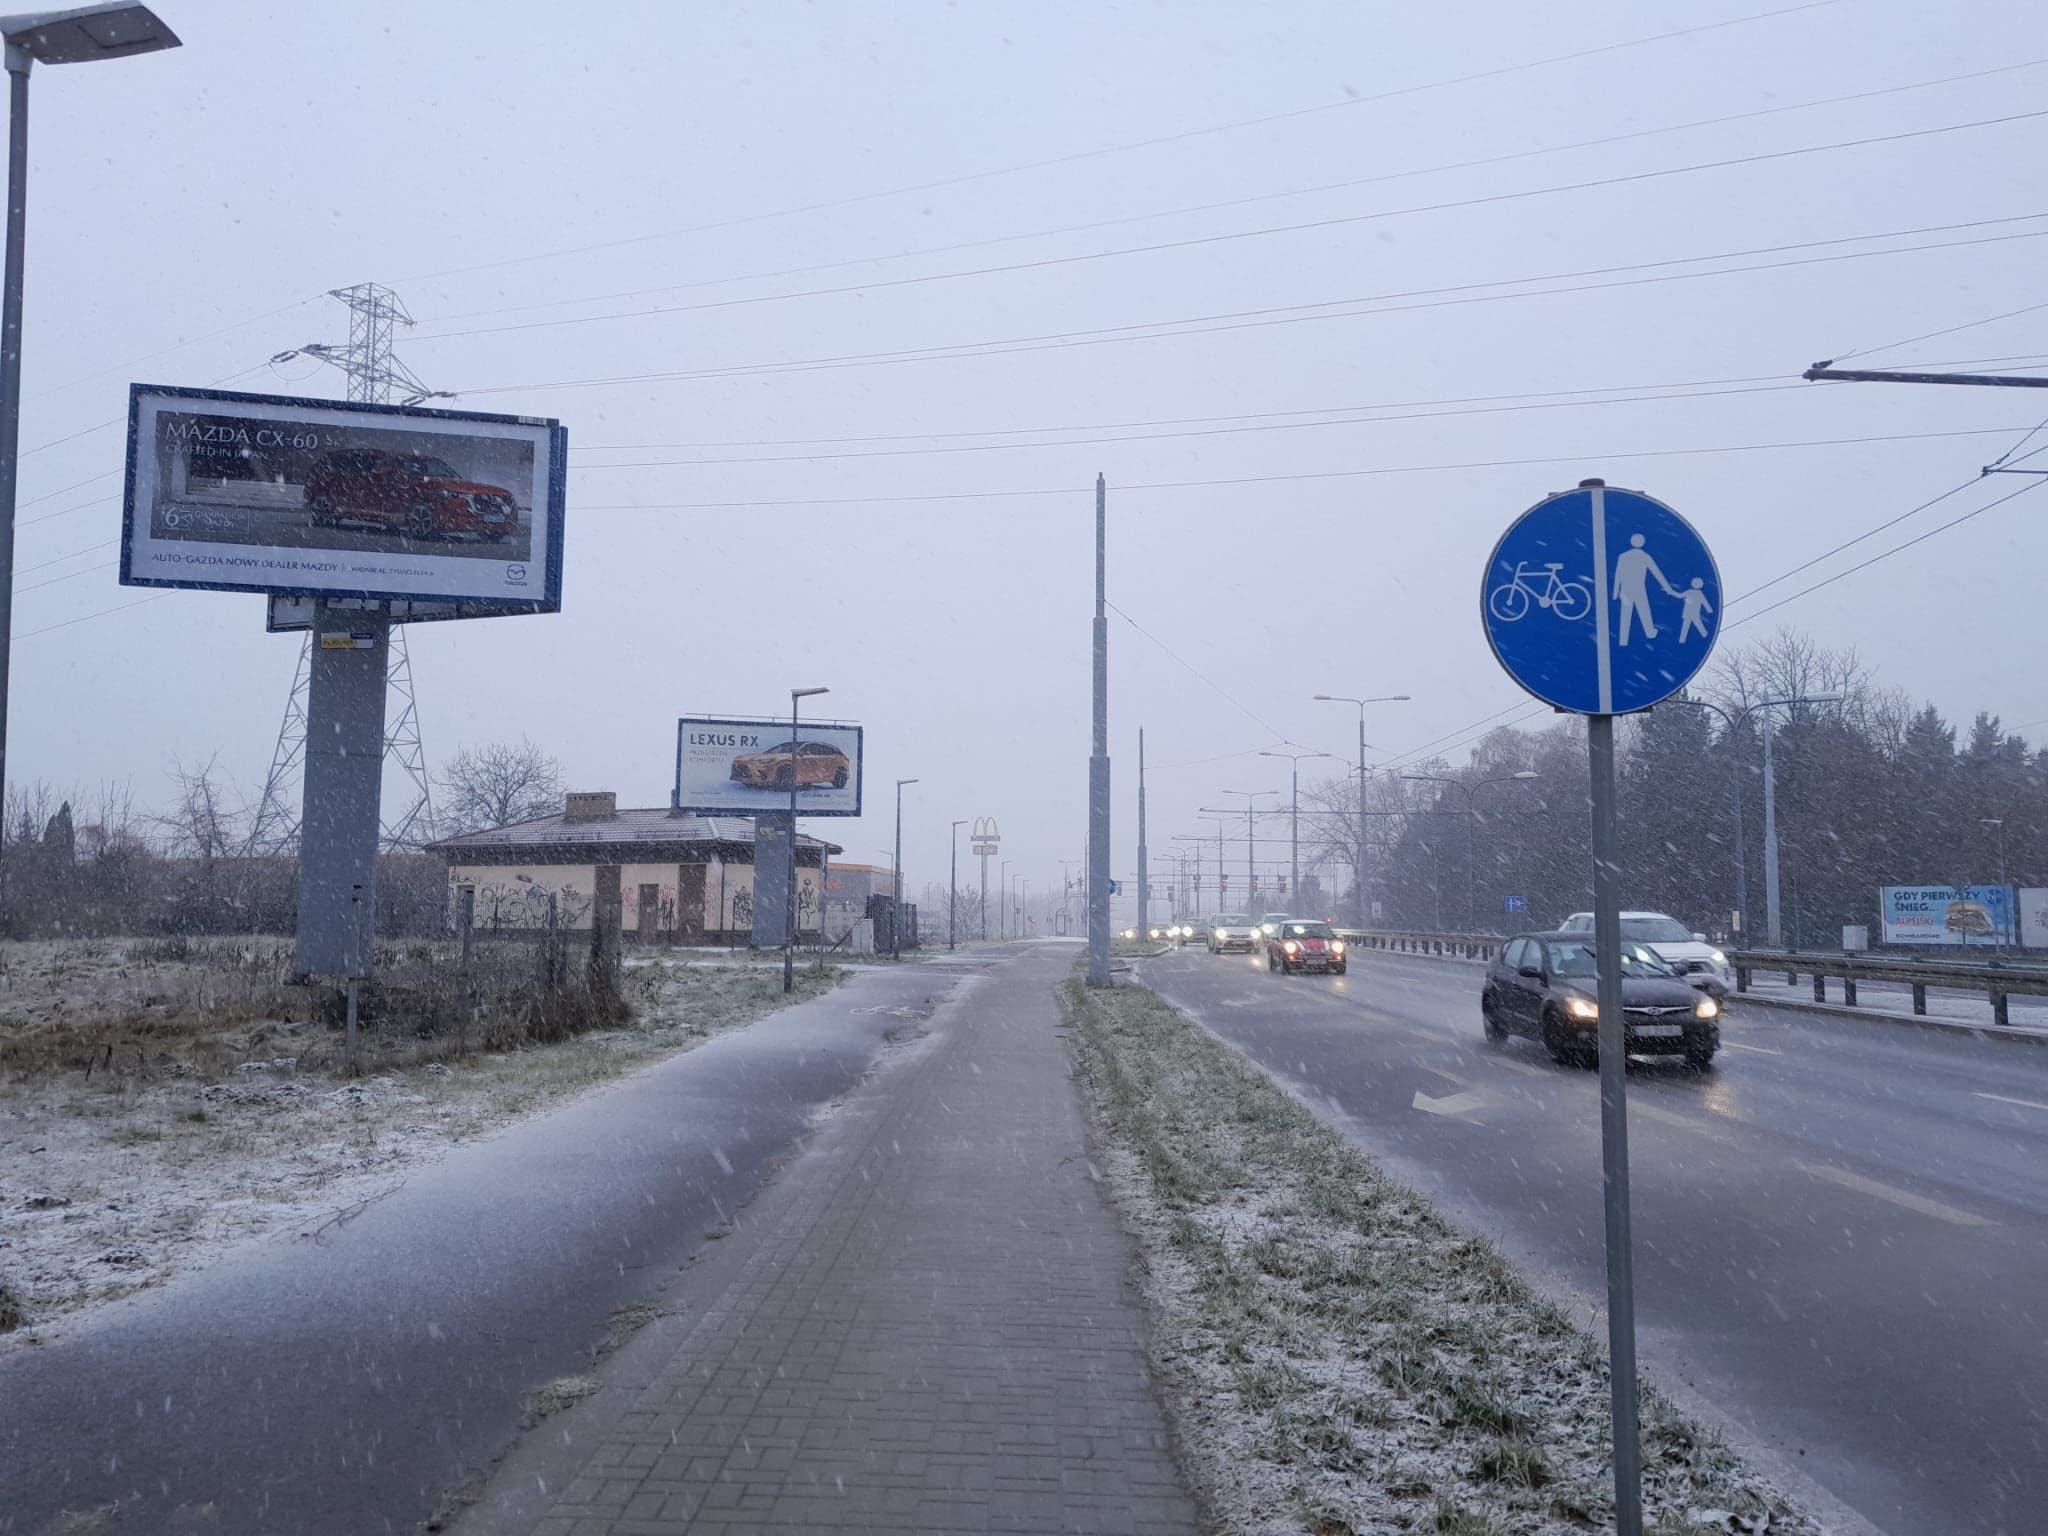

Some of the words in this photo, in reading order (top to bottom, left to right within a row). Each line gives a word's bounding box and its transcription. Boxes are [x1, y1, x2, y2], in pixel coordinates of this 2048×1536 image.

[166, 422, 250, 444] MAZDA
[256, 429, 318, 450] CX-60
[219, 448, 232, 458] IN
[152, 552, 224, 565] AUTO-GAZDA
[225, 557, 260, 568] NOWY
[261, 559, 299, 571] DEALER
[300, 561, 338, 573] MAZDY
[690, 733, 736, 746] LEXUS
[740, 735, 759, 748] RX
[1894, 891, 1919, 901] GDY
